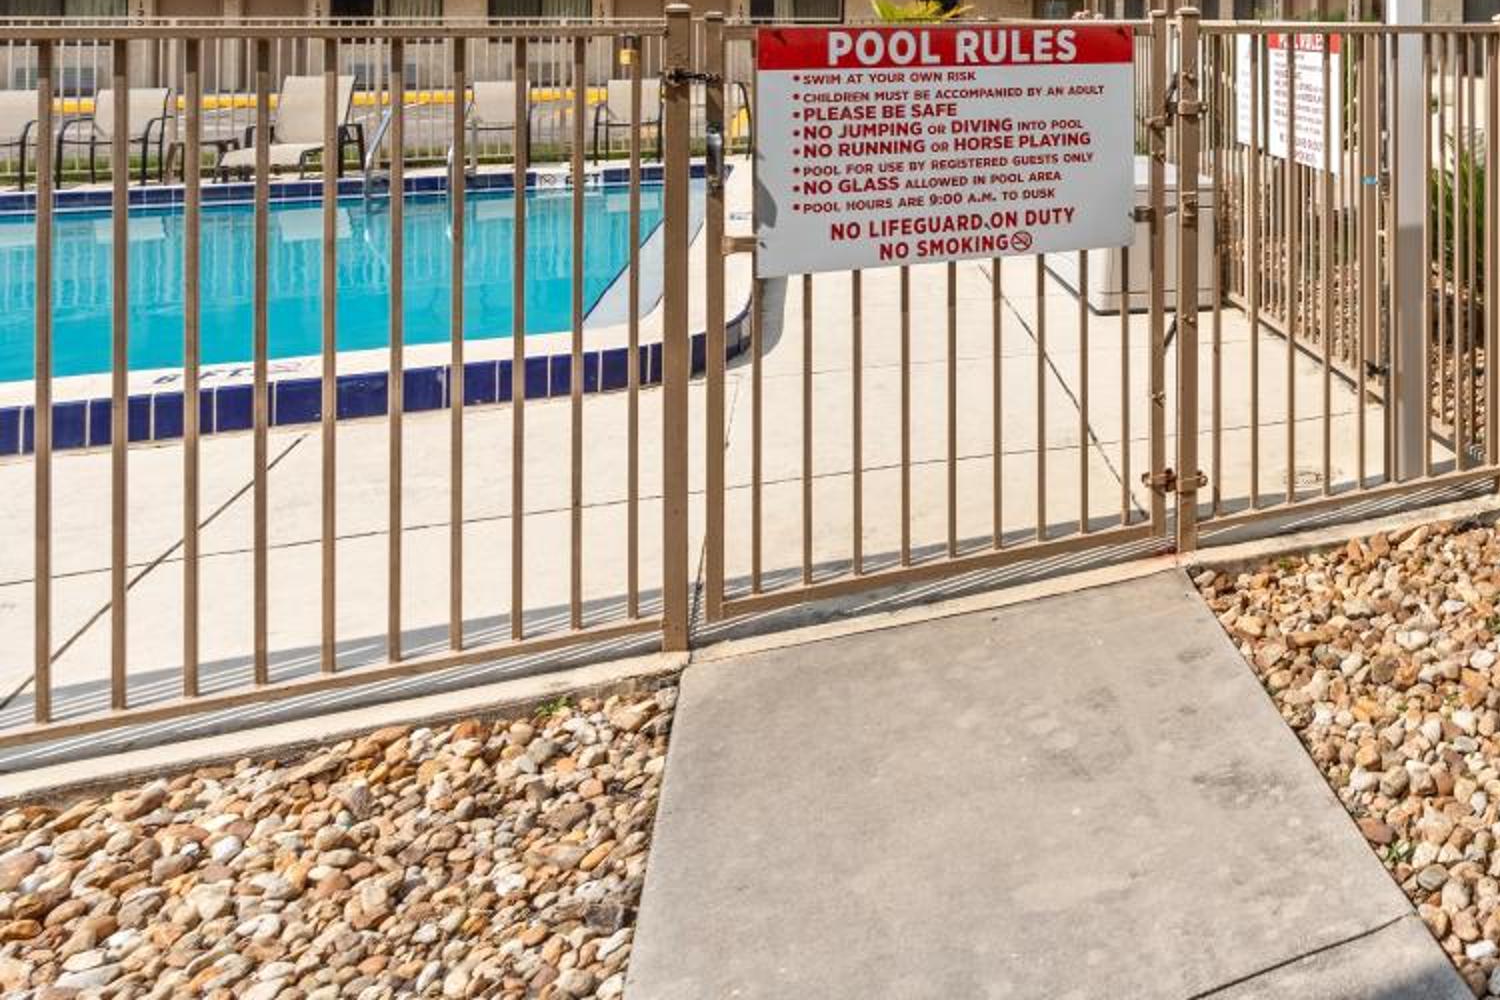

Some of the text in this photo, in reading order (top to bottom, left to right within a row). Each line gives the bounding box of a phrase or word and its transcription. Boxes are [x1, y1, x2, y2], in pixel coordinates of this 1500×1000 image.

[828, 28, 1077, 66] POOL RULES
[803, 71, 977, 85] SWIM AT YOUR OWN RISK
[803, 85, 1105, 103] CHILDREN MUST BE ACCOMPANIED BY AN ADULT
[803, 103, 957, 121] PLEASE BE SAFE
[803, 125, 833, 139] NO
[838, 122, 922, 138] JUMPING
[951, 118, 1013, 134] DIVING
[1017, 120, 1047, 131] INTO
[1051, 119, 1083, 130] POOL
[803, 132, 1091, 158] NO RUNNING OR HORSE PLAYING
[803, 151, 1094, 177] POOL FOR USE BY REGISTERED GUESTS ONLY
[803, 171, 1062, 195] NO GLASS ALLOWED IN POOL AREA
[803, 187, 1056, 214] POOL HOURS ARE 9:00 A.M. TO DUSK
[831, 206, 1075, 240] NO LIFEGUARD ON DUTY
[880, 233, 1009, 261] NO SMOKING
